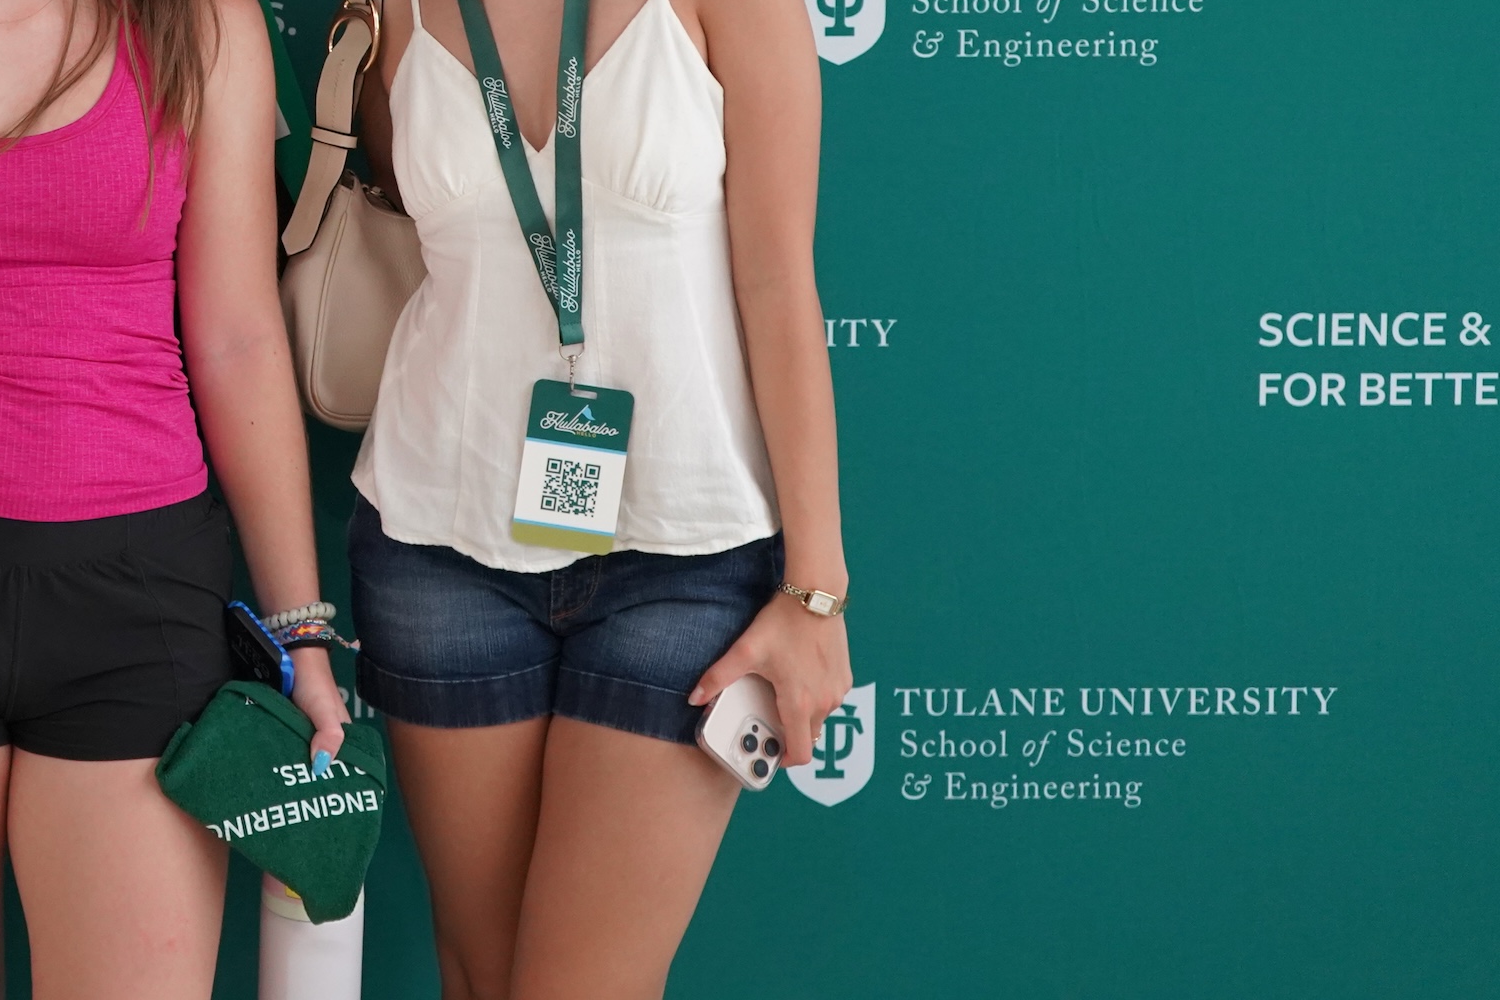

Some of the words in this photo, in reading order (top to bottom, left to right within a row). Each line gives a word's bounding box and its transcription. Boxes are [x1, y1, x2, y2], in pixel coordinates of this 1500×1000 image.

[912, 29, 945, 59] &
[956, 29, 1159, 68] Engineering
[1258, 311, 1447, 348] SCIENCE
[1459, 311, 1491, 347] &
[1258, 372, 1346, 407] FOR
[540, 404, 620, 437] Hullabaloo
[893, 687, 1066, 717] TULANE
[1079, 686, 1338, 716] UNIVERSITY
[900, 729, 1008, 758] School
[1022, 729, 1057, 768] of
[1067, 728, 1186, 757] Science
[901, 772, 932, 801] &
[944, 771, 1143, 809] Engineering
